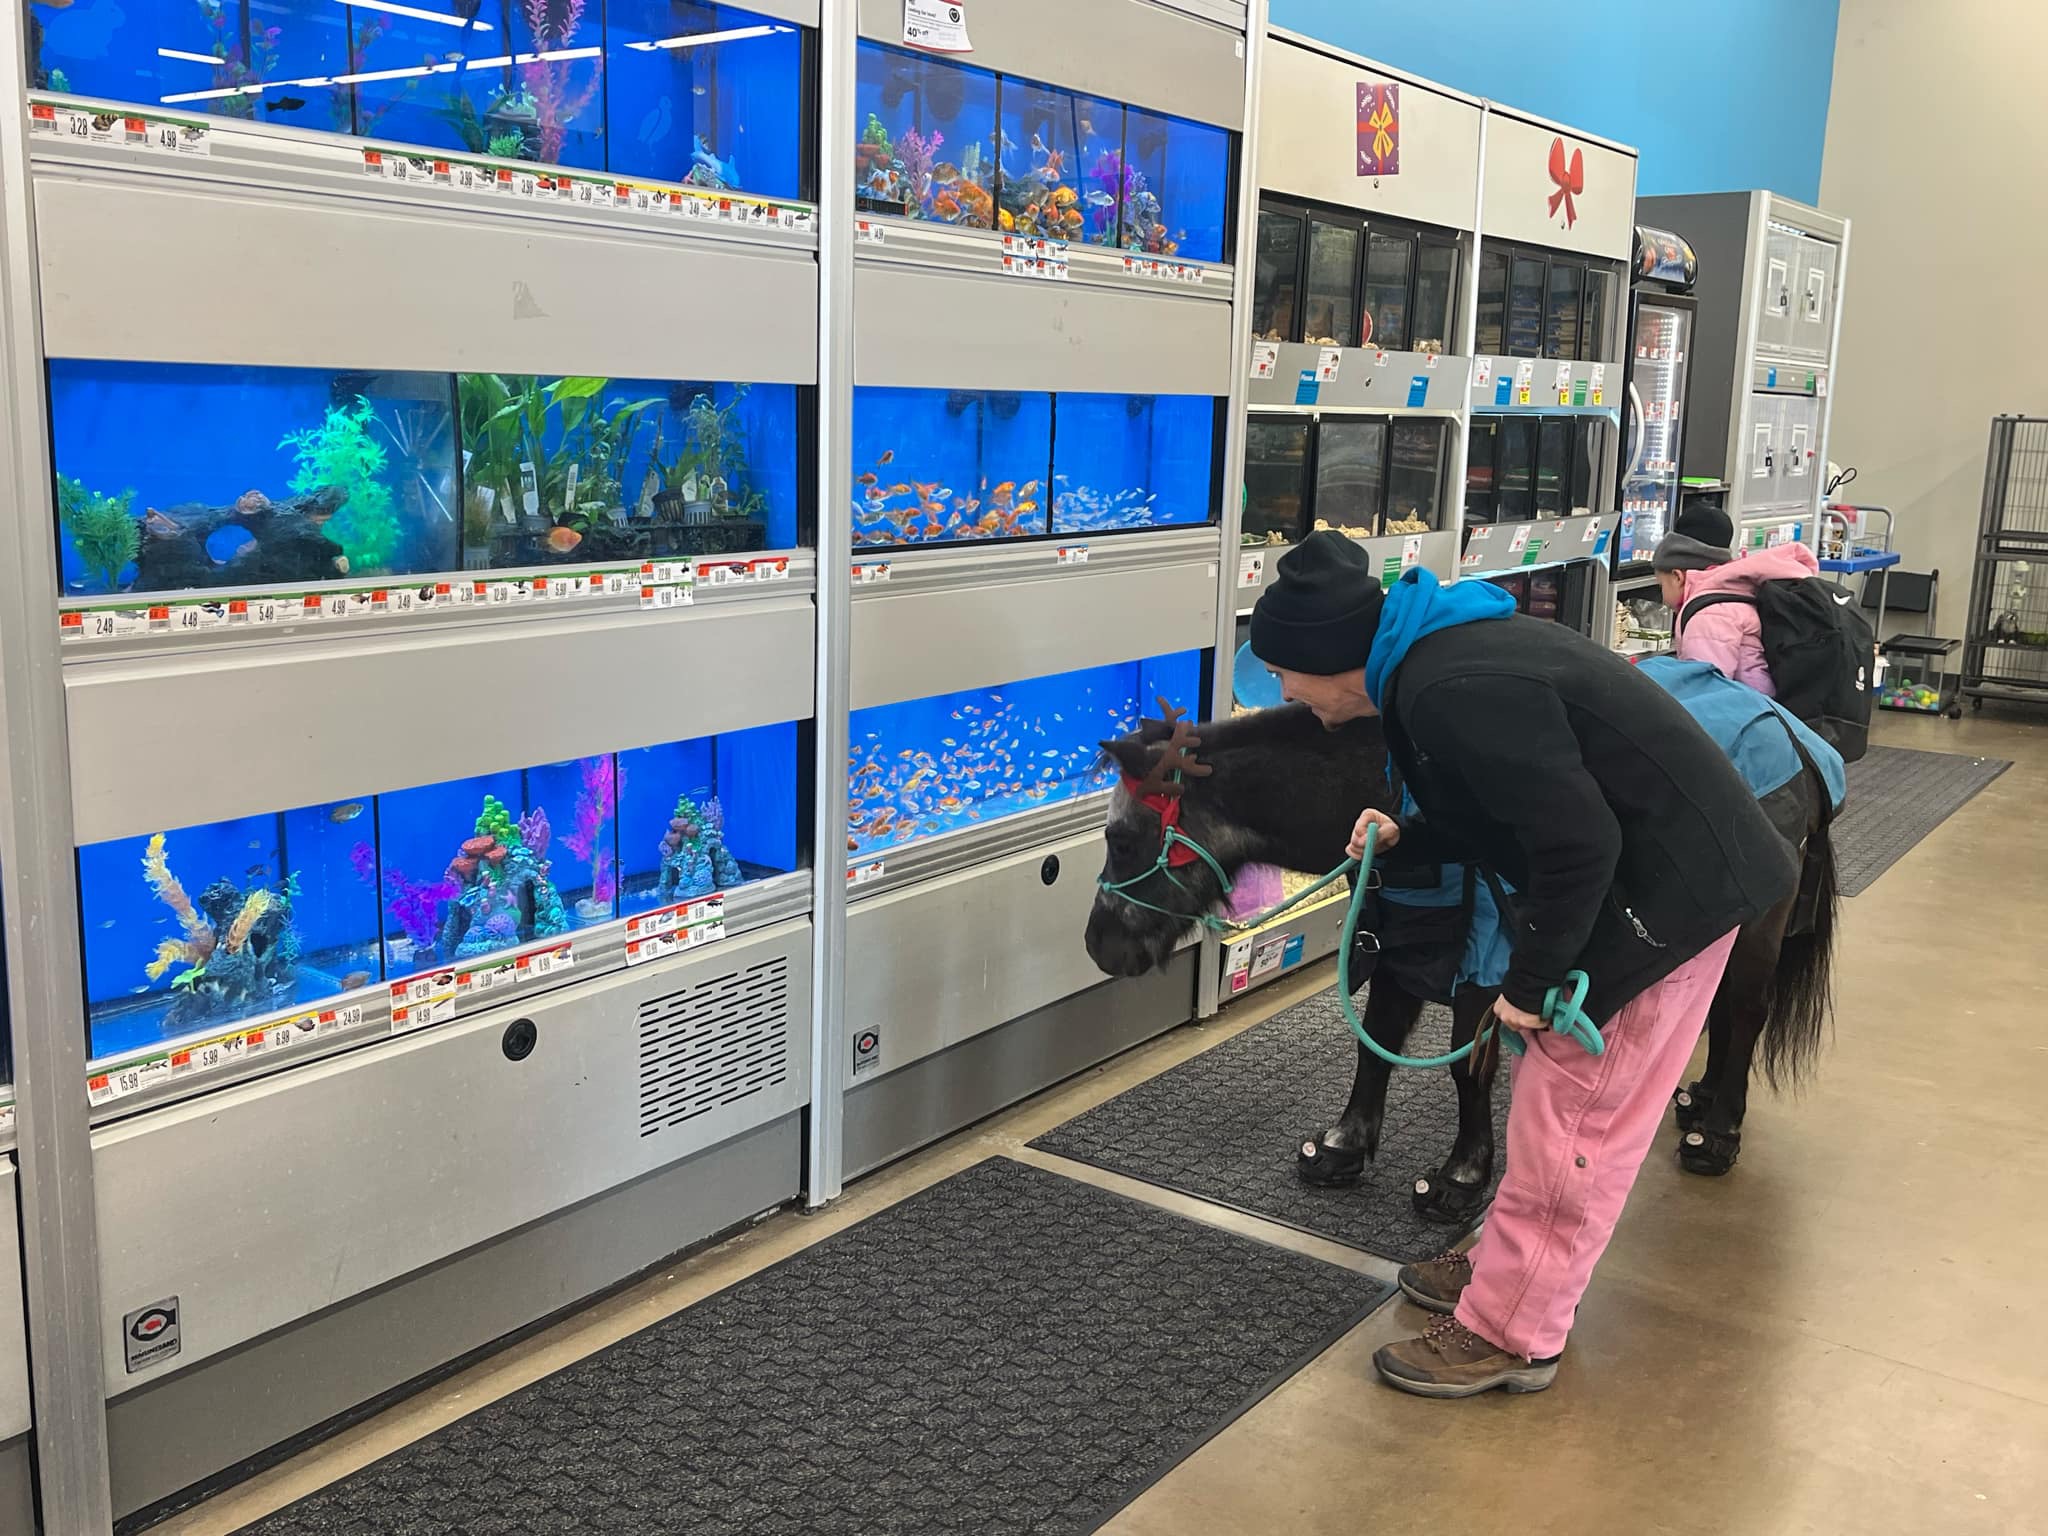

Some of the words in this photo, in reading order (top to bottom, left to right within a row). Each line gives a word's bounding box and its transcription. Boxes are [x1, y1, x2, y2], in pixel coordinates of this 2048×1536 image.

[70, 116, 88, 136] 3.28
[160, 128, 177, 149] 4.98
[259, 605, 274, 621] 5.48
[332, 599, 346, 615] 4.98
[96, 617, 113, 635] 2.48
[182, 611, 198, 627] 4.48
[415, 982, 430, 999] 12.98
[343, 1008, 360, 1026] 24.98
[276, 1030, 290, 1046] 6.98
[203, 1048, 218, 1067] 5.98
[120, 1072, 139, 1092] 15.98
